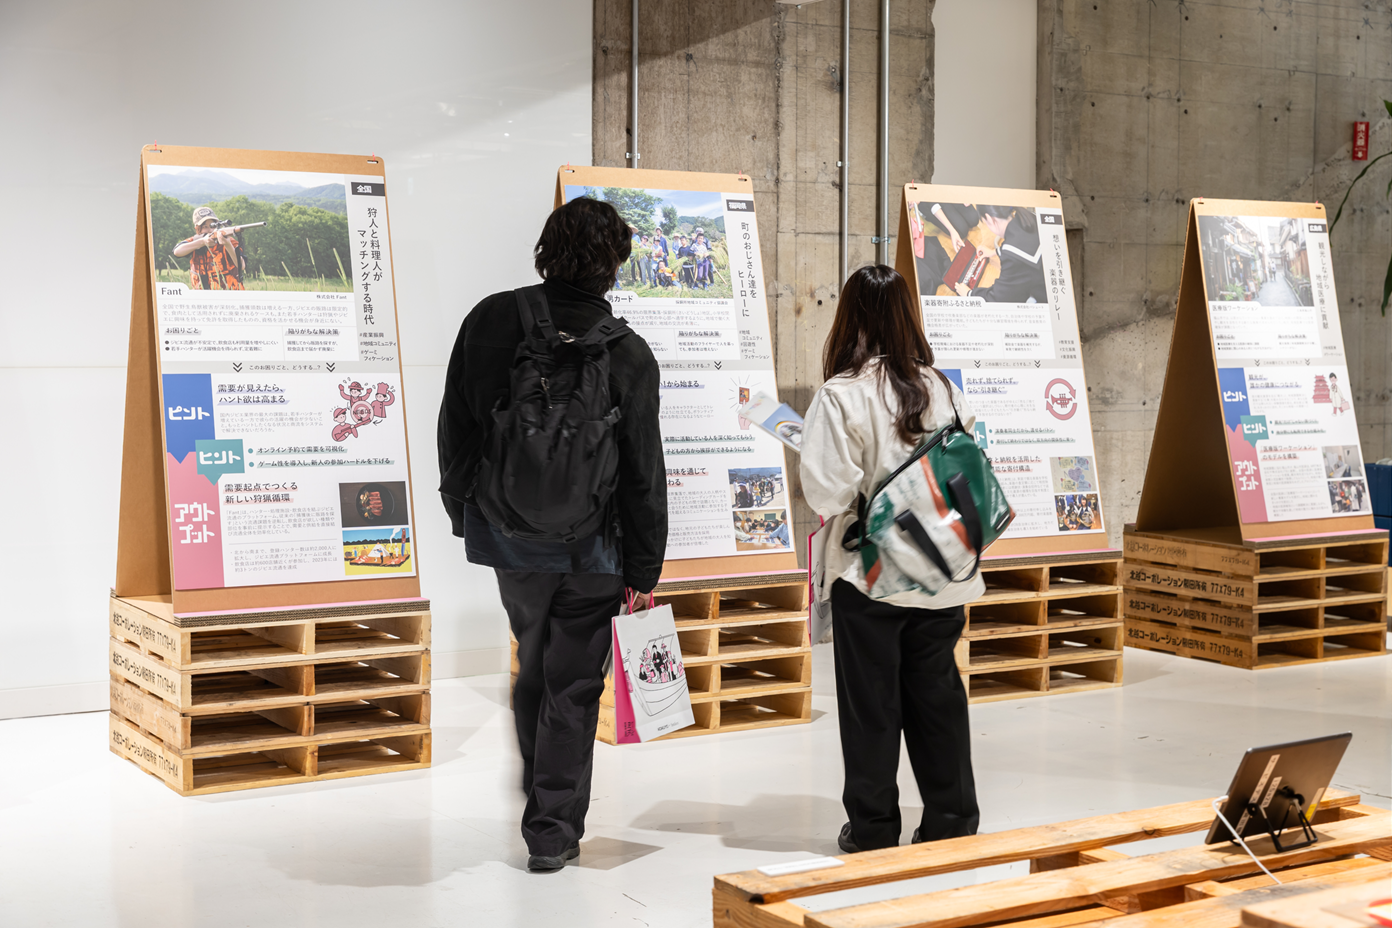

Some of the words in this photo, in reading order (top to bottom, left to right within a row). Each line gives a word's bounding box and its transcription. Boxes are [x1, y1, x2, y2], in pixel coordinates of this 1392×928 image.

[357, 184, 372, 194] 全国
[367, 207, 383, 282] 狩人と料理人が
[741, 222, 757, 298] 町のおじさん達を
[1052, 234, 1066, 294] 想いを引き継ぐ
[357, 229, 375, 326] マッチングする時代
[161, 287, 182, 296] Fant
[738, 270, 750, 317] ヒーローに
[1049, 269, 1061, 320] 楽器のリレー
[166, 327, 199, 335] お困りごと
[217, 383, 284, 393] 需要が見えたら、
[219, 395, 286, 404] ハント欲は高まる
[1223, 391, 1247, 402] ピント
[168, 405, 211, 421] ピント
[1243, 423, 1266, 434] ヒント
[199, 450, 241, 465] ヒント
[1235, 460, 1257, 475] アウト
[224, 482, 298, 492] 需要起点でつくる
[1239, 476, 1259, 490] プット
[225, 493, 290, 504] 新しい狩猟循環
[175, 502, 215, 522] アウト
[179, 524, 215, 544] プット
